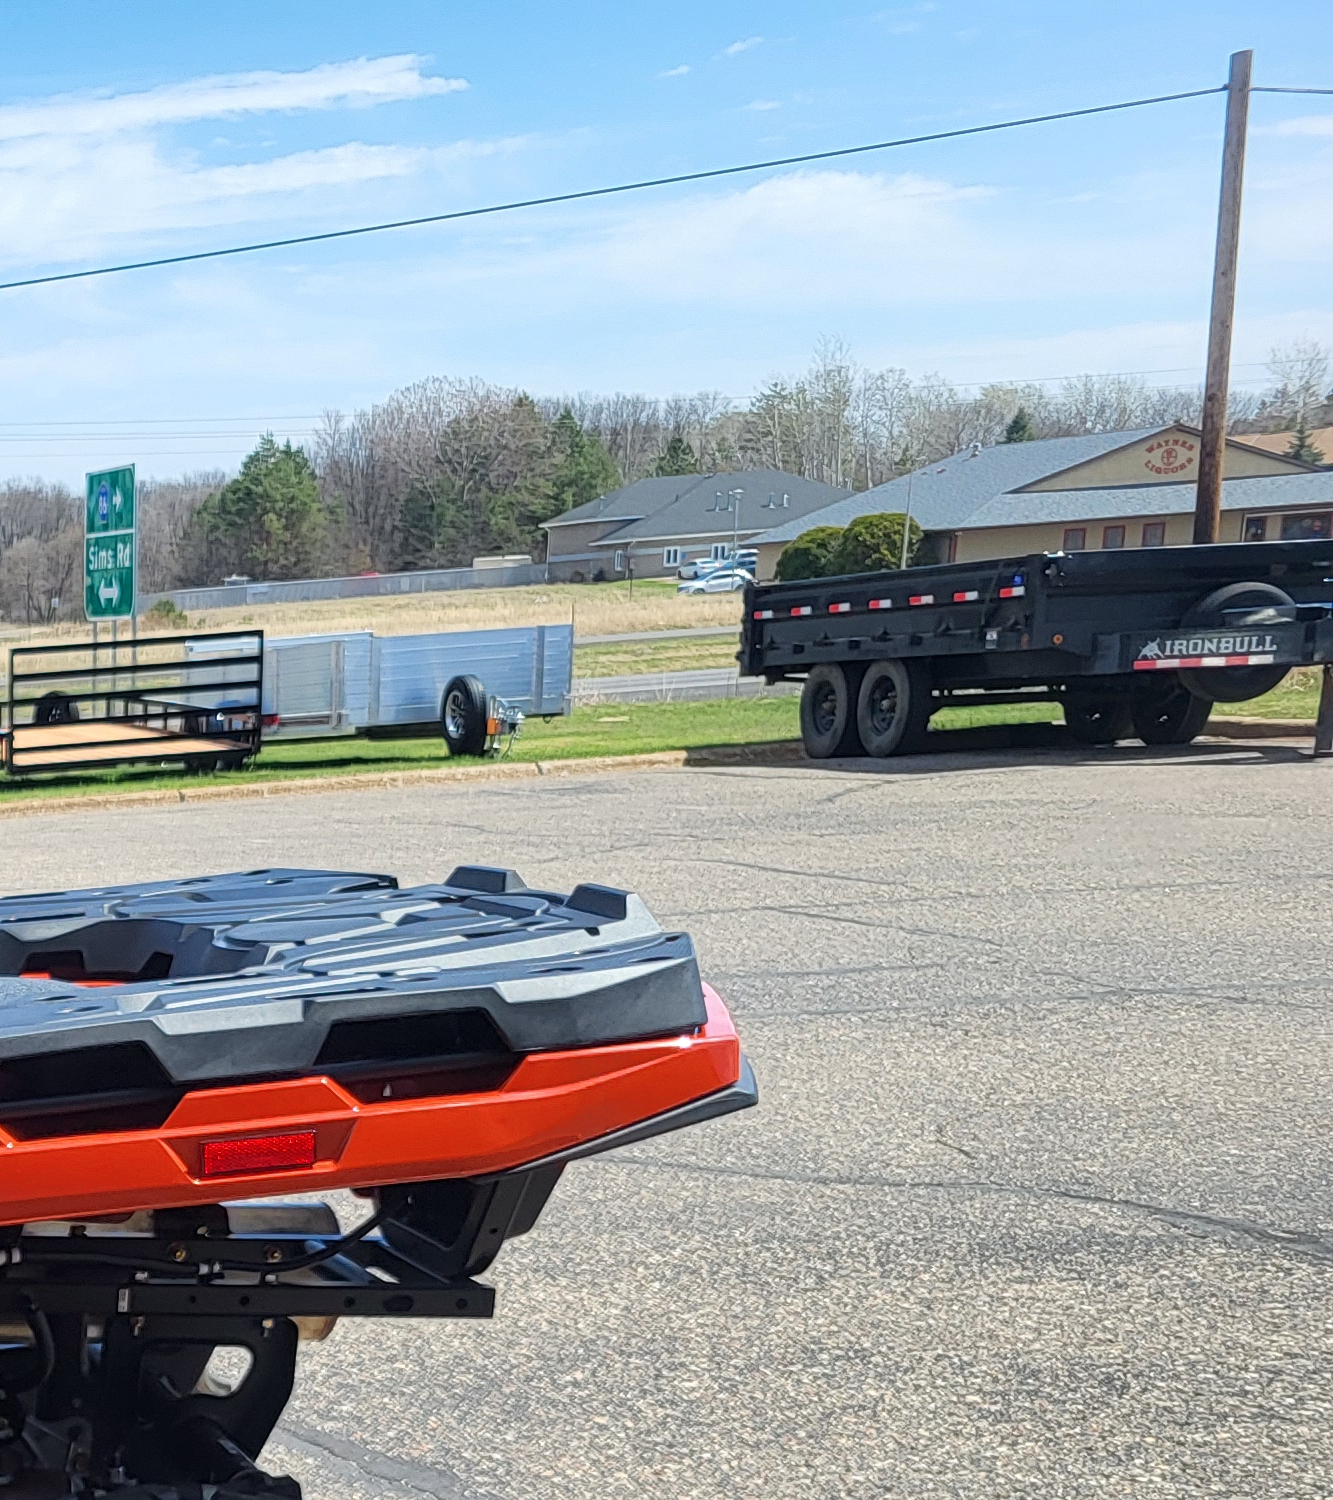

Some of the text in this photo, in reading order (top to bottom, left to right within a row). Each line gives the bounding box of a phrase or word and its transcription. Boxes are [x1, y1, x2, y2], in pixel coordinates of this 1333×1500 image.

[88, 542, 132, 571] Sims Rd
[1164, 635, 1277, 656] IRONBULL
